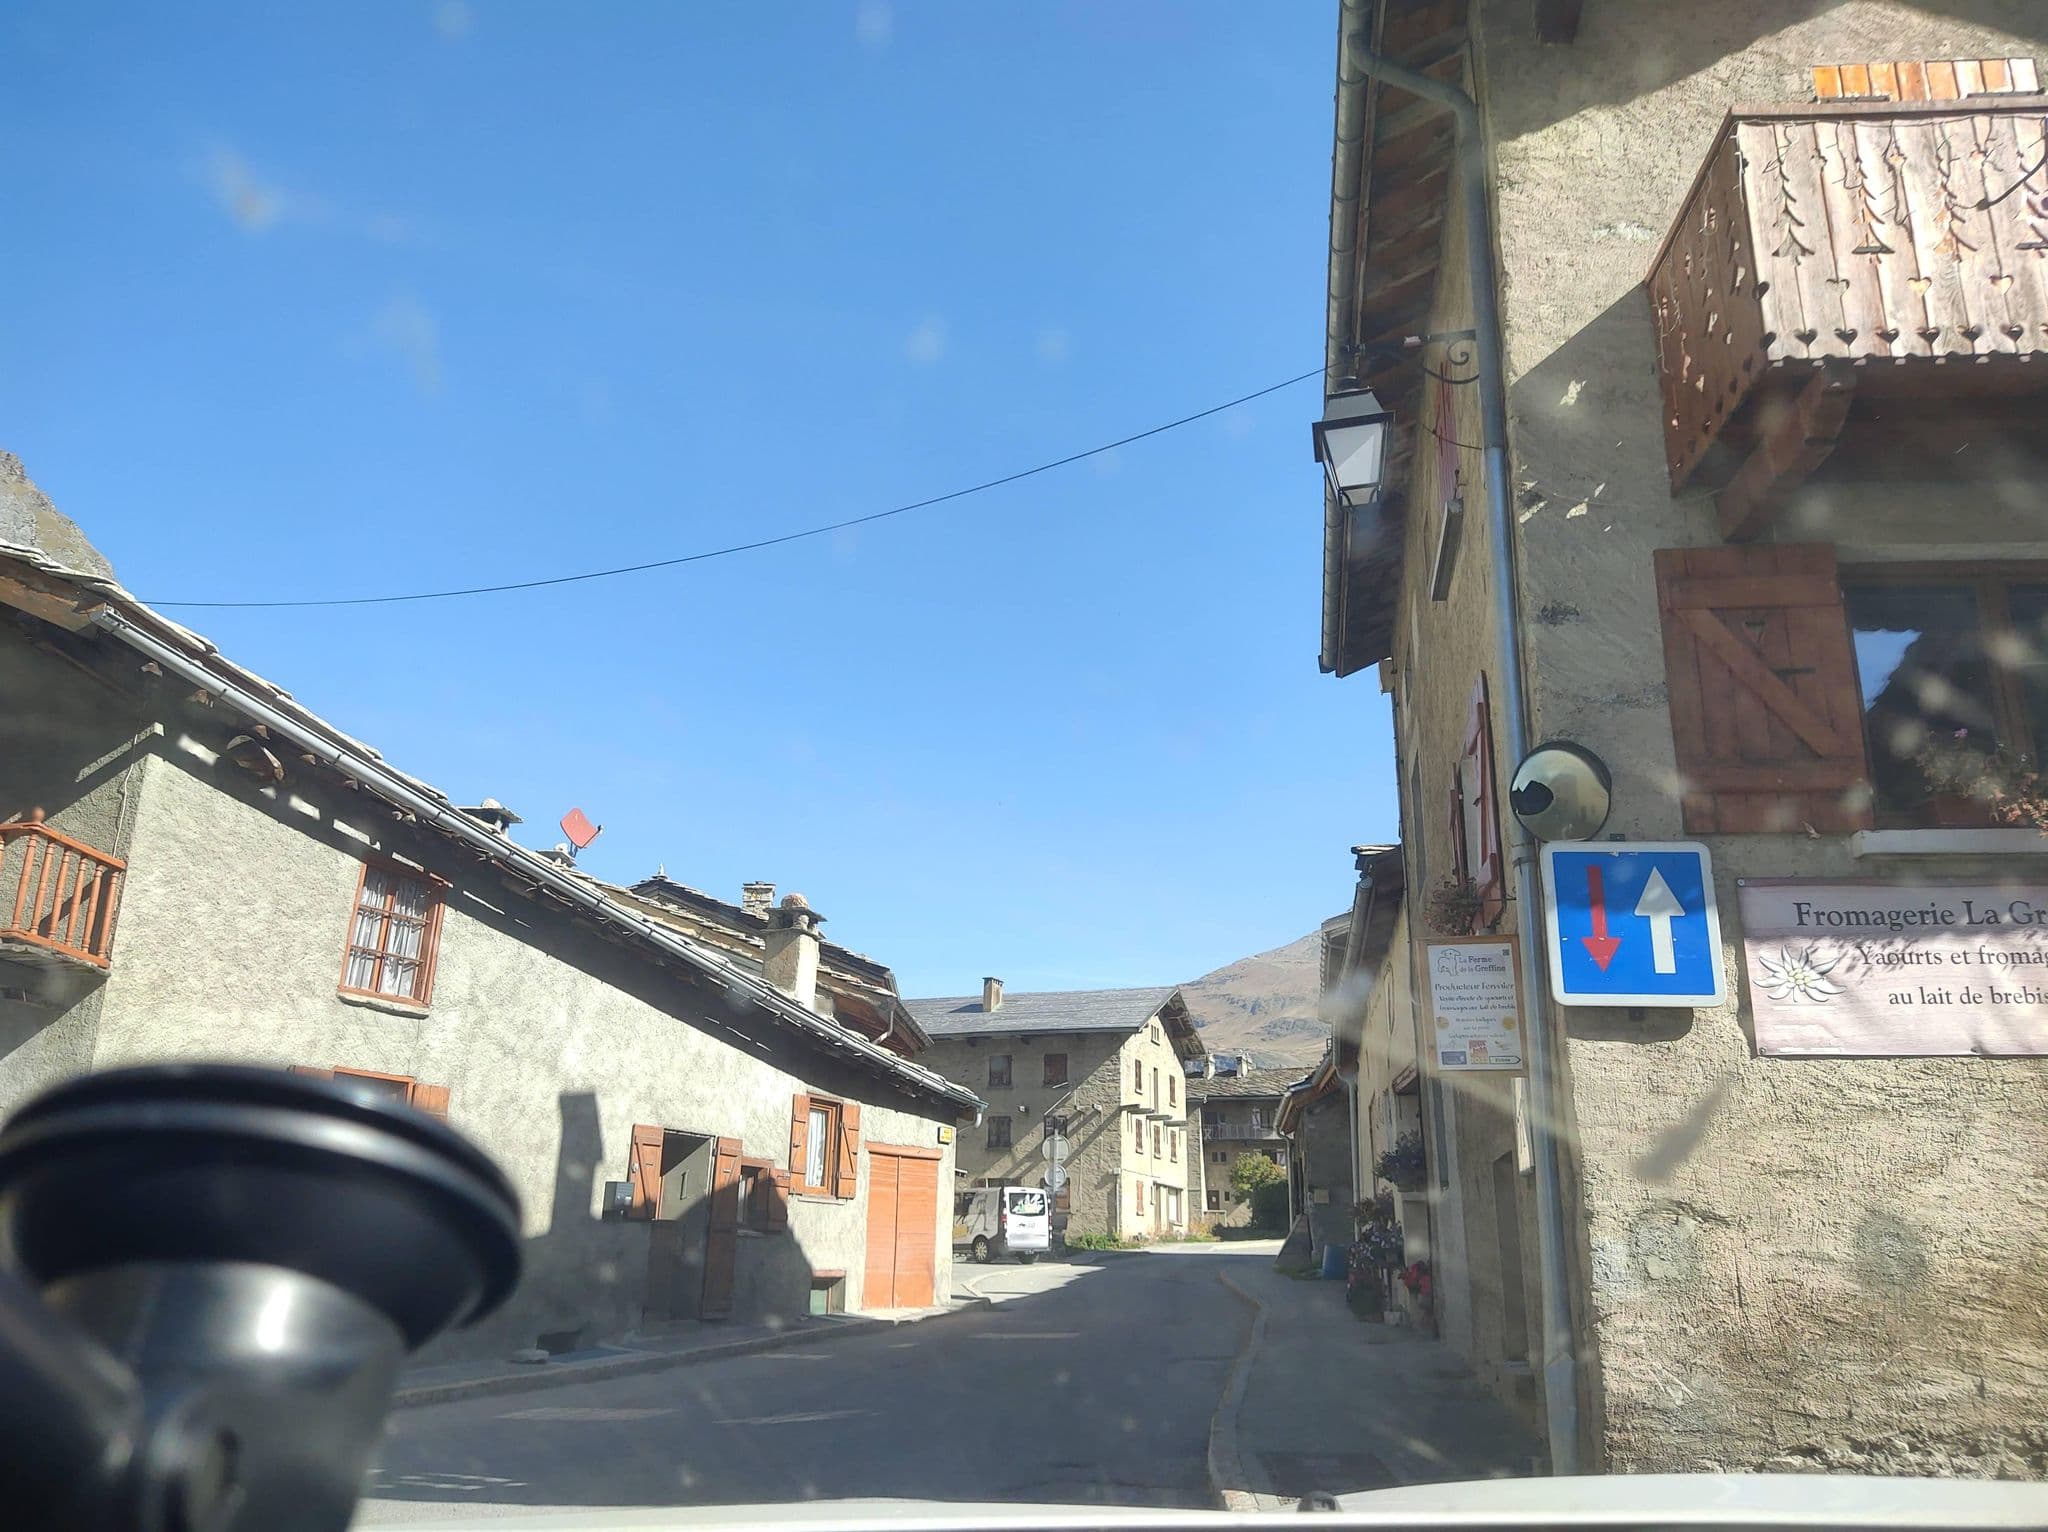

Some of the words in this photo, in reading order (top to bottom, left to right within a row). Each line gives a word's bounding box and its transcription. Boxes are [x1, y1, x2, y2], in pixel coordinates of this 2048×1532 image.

[1792, 902, 1956, 932] Fromagerie
[1961, 899, 2001, 926] La
[1468, 955, 1493, 963] Ferme
[1856, 945, 1942, 966] Yaourts
[1950, 950, 1972, 965] et
[1475, 964, 1506, 973] Greffine
[1889, 992, 1913, 1005] au
[1920, 985, 1952, 1006] lait
[1959, 985, 1983, 1005] de
